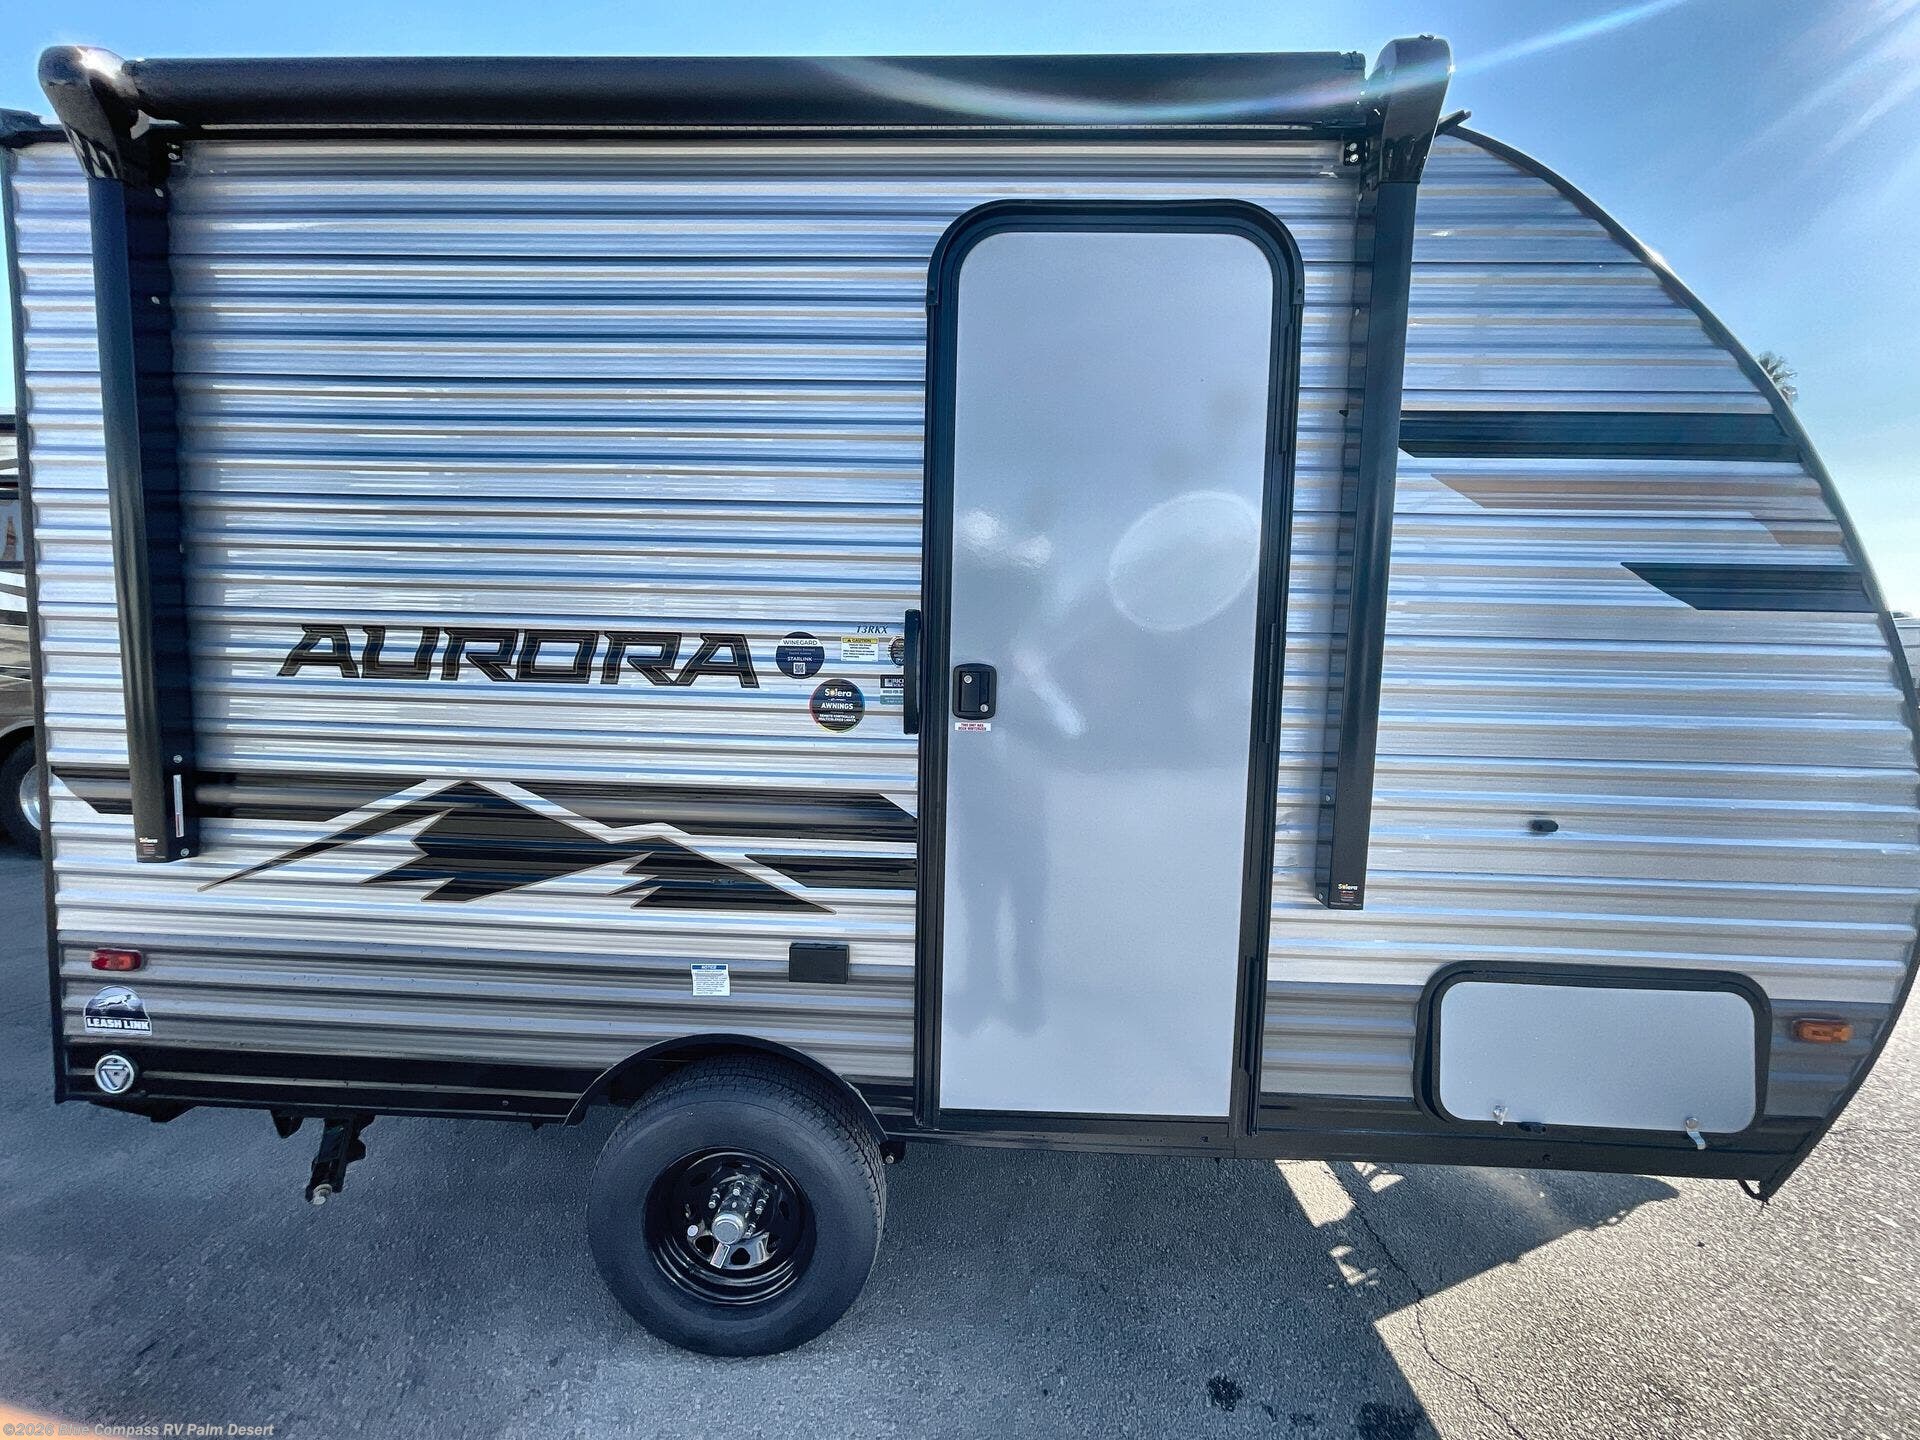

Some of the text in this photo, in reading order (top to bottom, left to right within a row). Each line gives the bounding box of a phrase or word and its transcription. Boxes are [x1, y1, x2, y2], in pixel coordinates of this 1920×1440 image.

[276, 623, 760, 689] AURORA
[824, 688, 852, 697] Solera
[821, 702, 854, 710] AWNINGS
[87, 1018, 149, 1030] LEASH LINK
